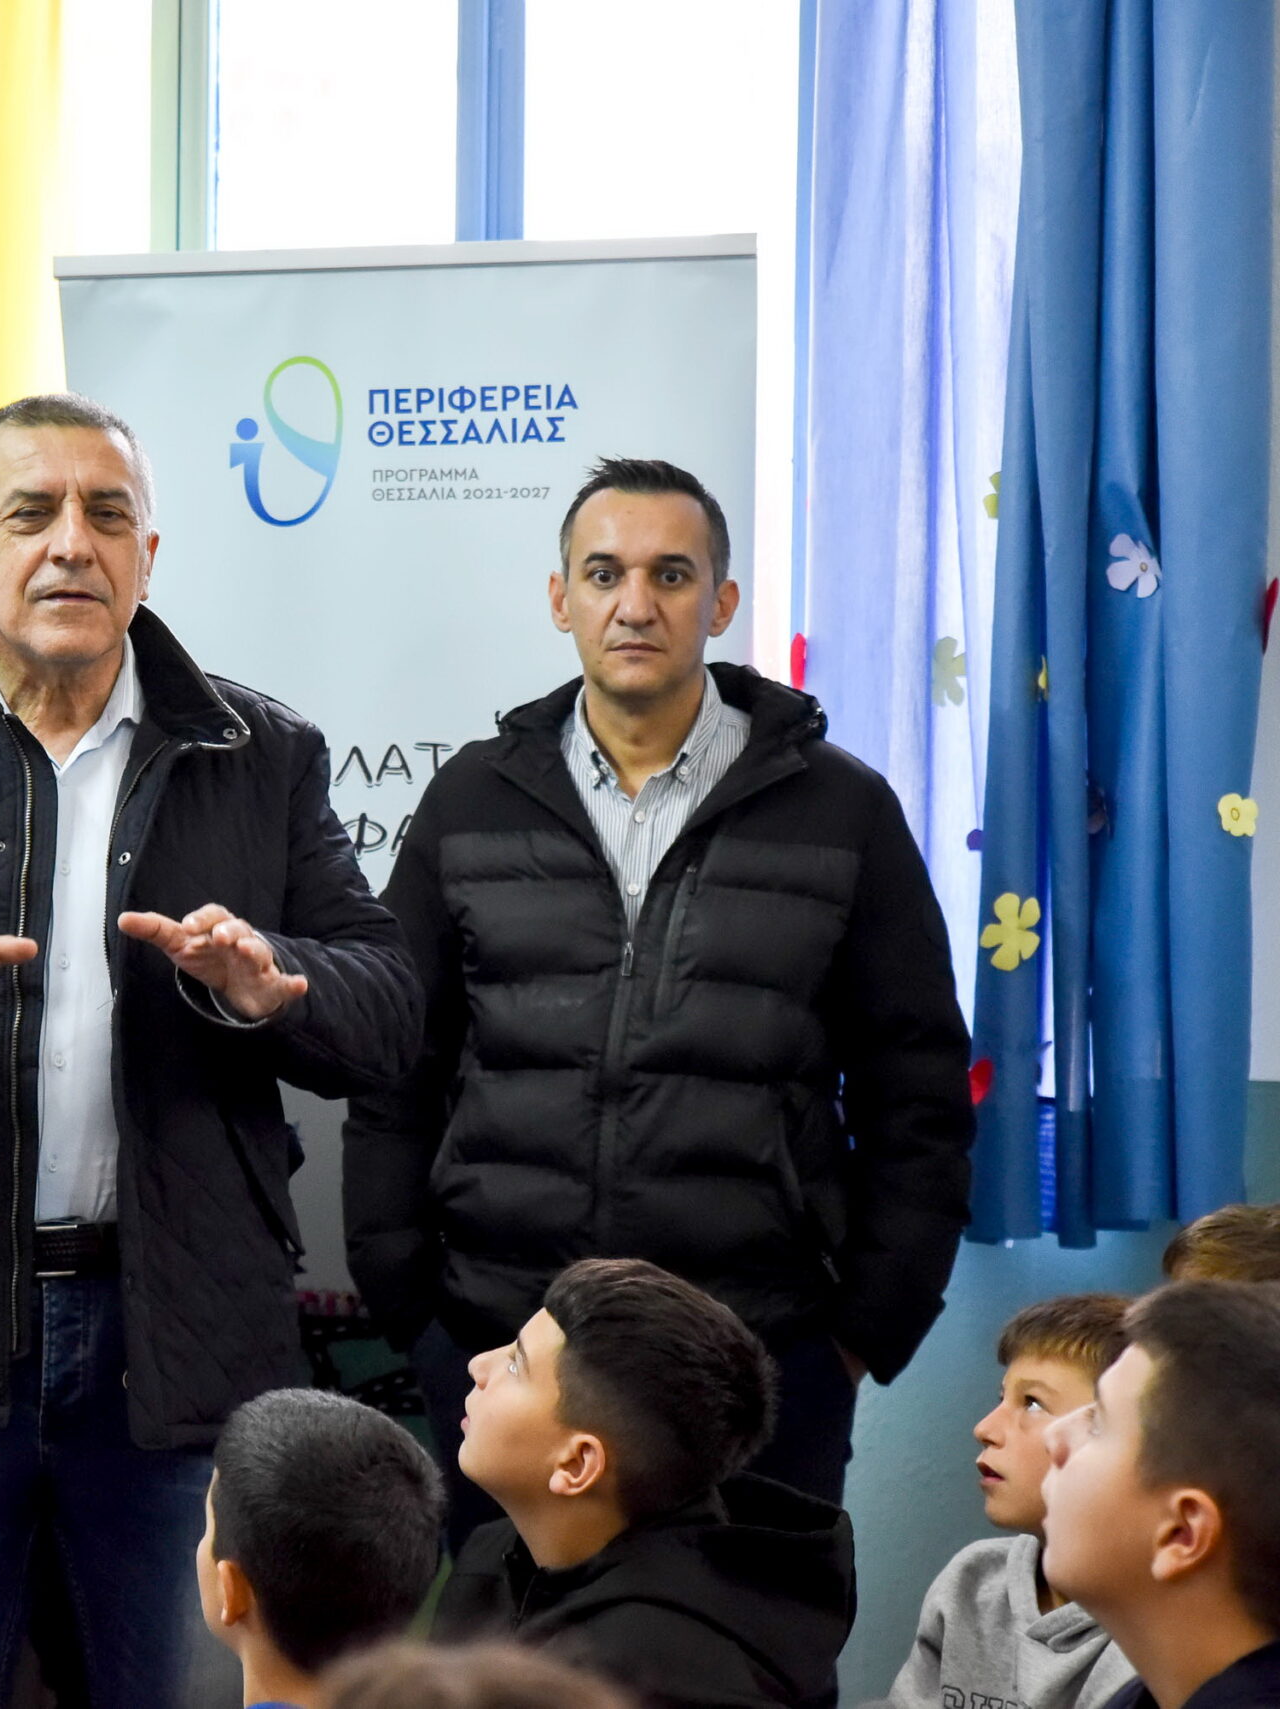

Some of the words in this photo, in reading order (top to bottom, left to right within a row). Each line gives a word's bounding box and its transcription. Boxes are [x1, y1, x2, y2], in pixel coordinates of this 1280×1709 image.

[368, 384, 579, 415] ΠΕΡΙΦΕΡΕΙΑ
[367, 416, 566, 447] ΘΕΣΣΑΛΙΑΣ
[372, 467, 479, 483] ΠΡΟΓΡΑΜΜΑ
[372, 487, 456, 502] ΘΕΣΣΑΛΙΑ
[462, 487, 551, 501] 2021-2027
